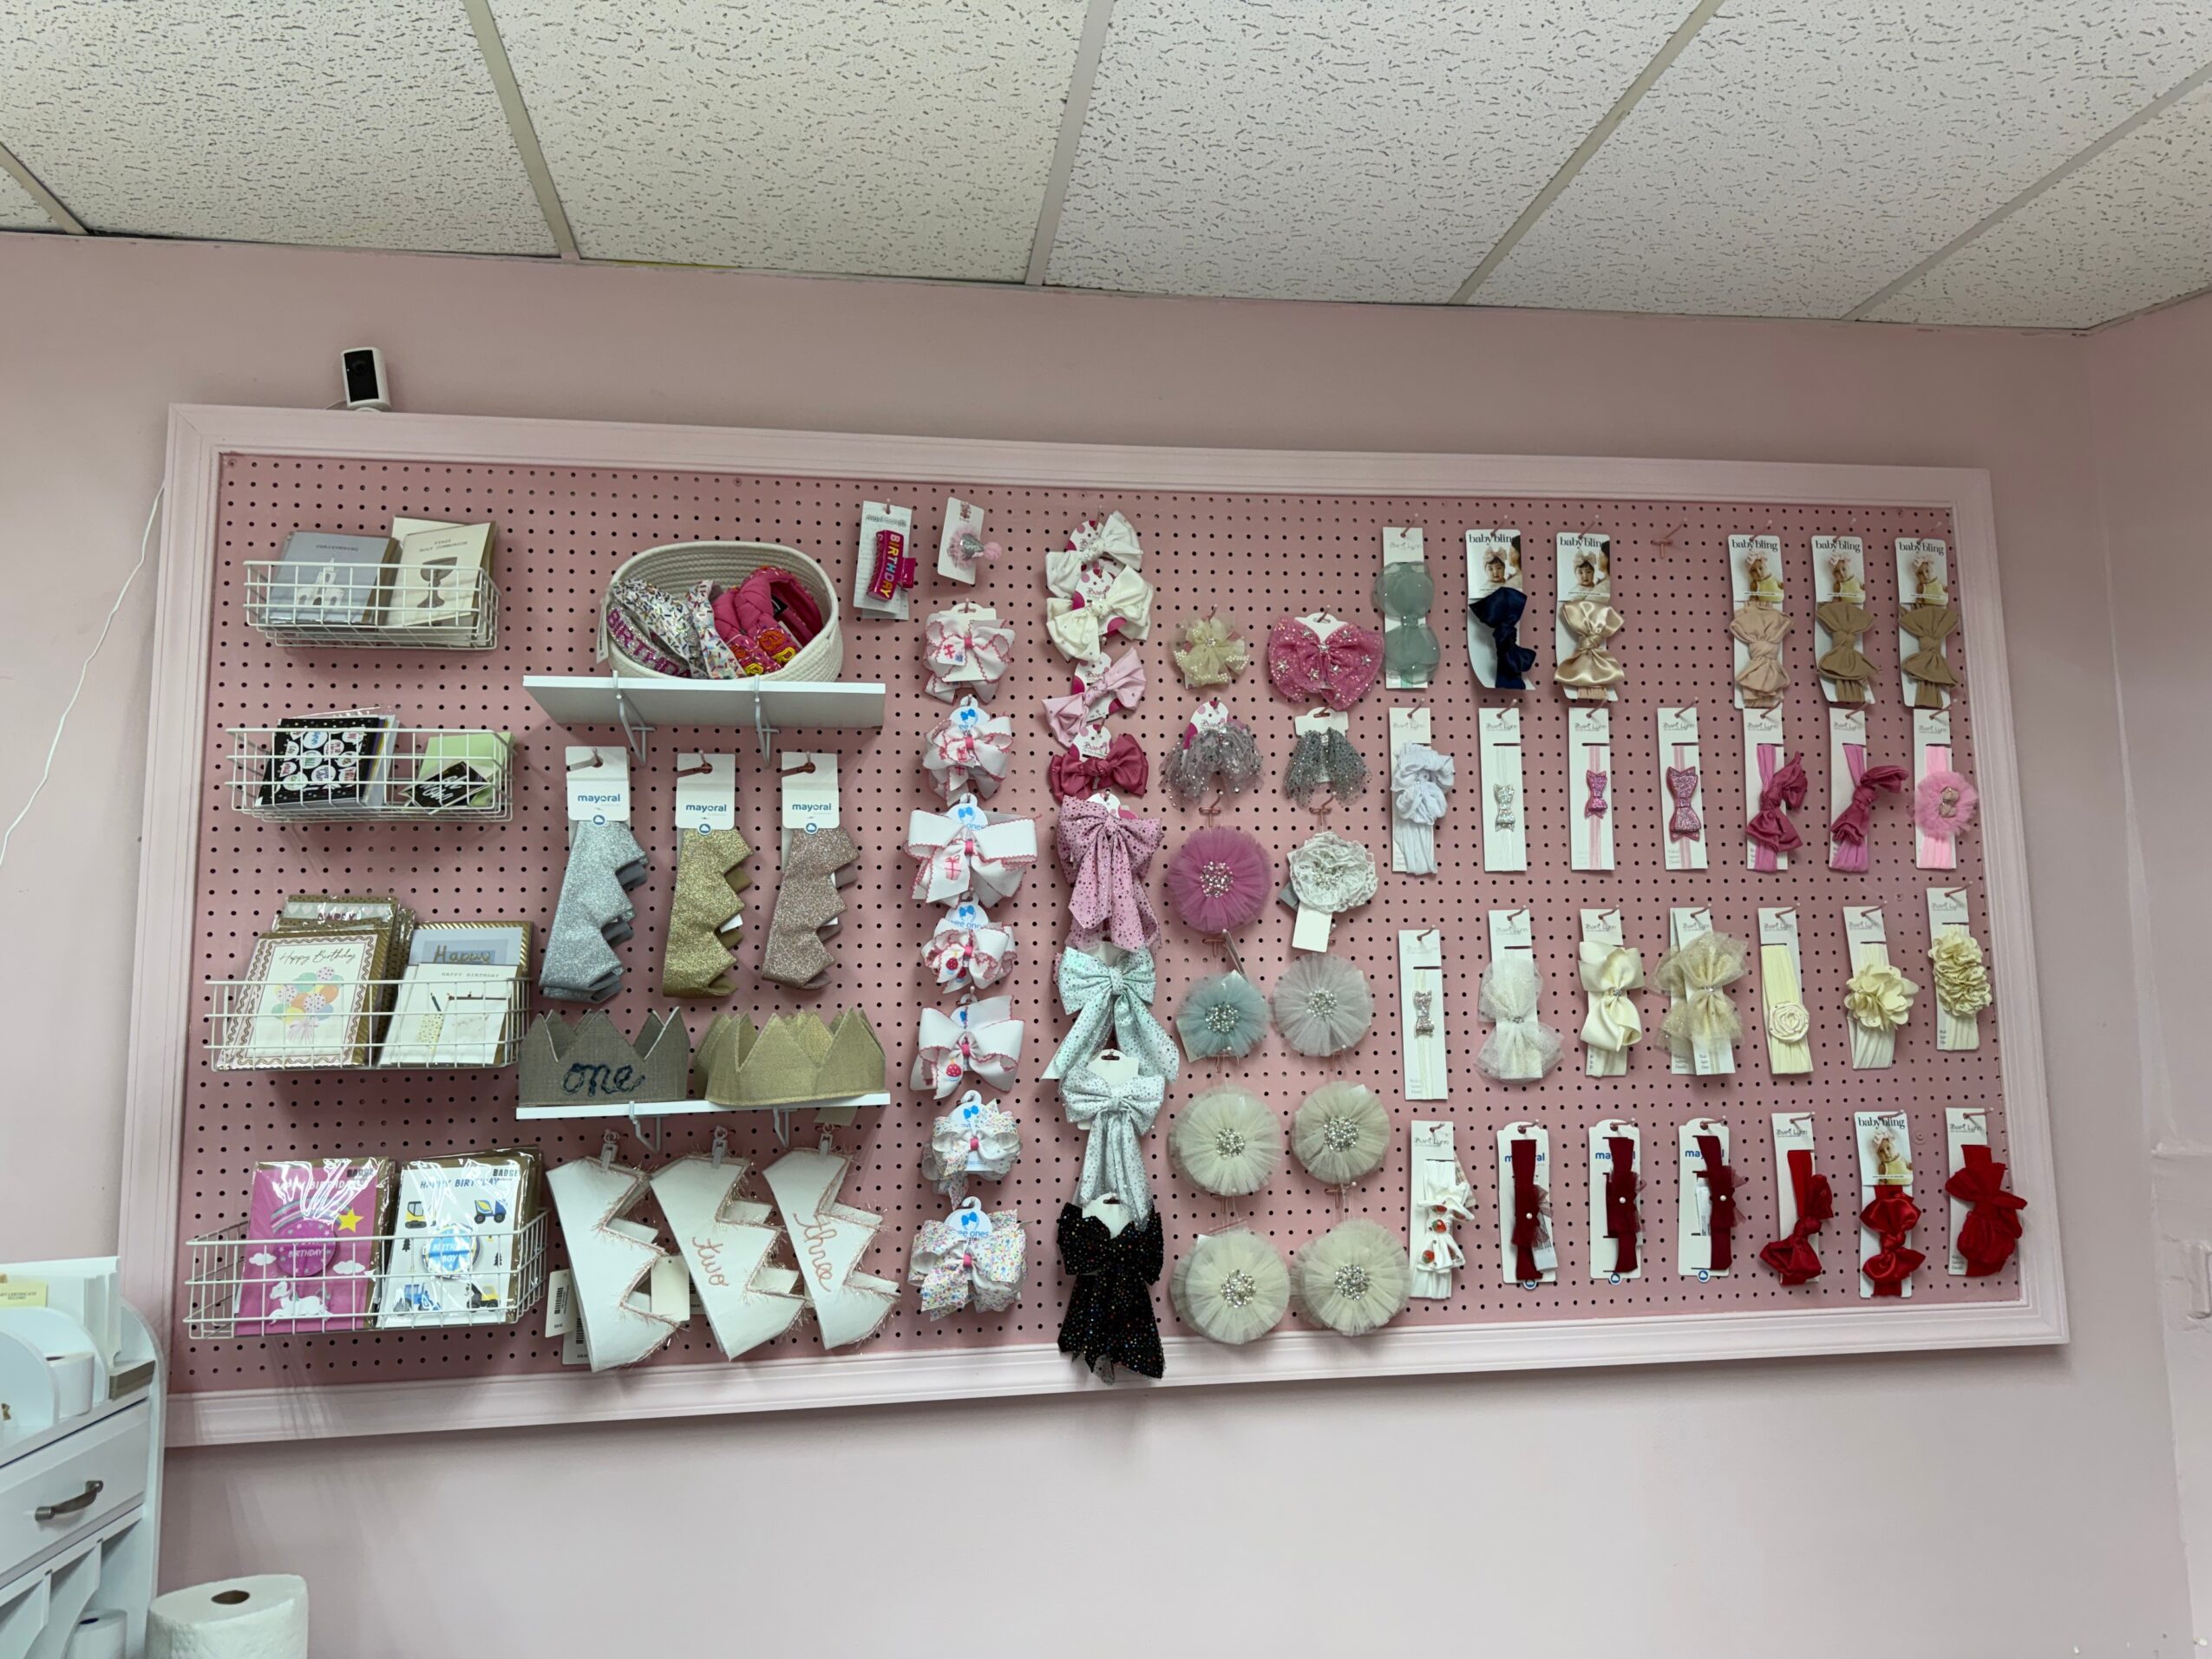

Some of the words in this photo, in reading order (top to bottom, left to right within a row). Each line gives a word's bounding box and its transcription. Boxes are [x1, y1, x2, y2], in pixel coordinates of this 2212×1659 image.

[1469, 534, 1491, 545] baby
[1560, 537, 1582, 549] baby
[1731, 539, 1754, 551] baby
[1755, 539, 1778, 552] bling
[1816, 539, 1837, 552] baby
[1838, 540, 1861, 553] bling
[1899, 541, 1921, 553] baby
[1922, 542, 1945, 556] bling
[880, 534, 900, 598] BIRTHDAY
[578, 794, 620, 804] mayoral
[685, 803, 727, 813] mayoral
[792, 803, 831, 813] mayoral
[279, 950, 310, 965] Happy
[312, 947, 356, 965] Birthday
[434, 944, 491, 963] Happy
[562, 1062, 645, 1097] one
[1857, 1116, 1880, 1130] baby
[1882, 1117, 1905, 1130] bling
[493, 1168, 518, 1178] BADGE
[793, 1212, 838, 1292] three
[691, 1237, 730, 1287] two
